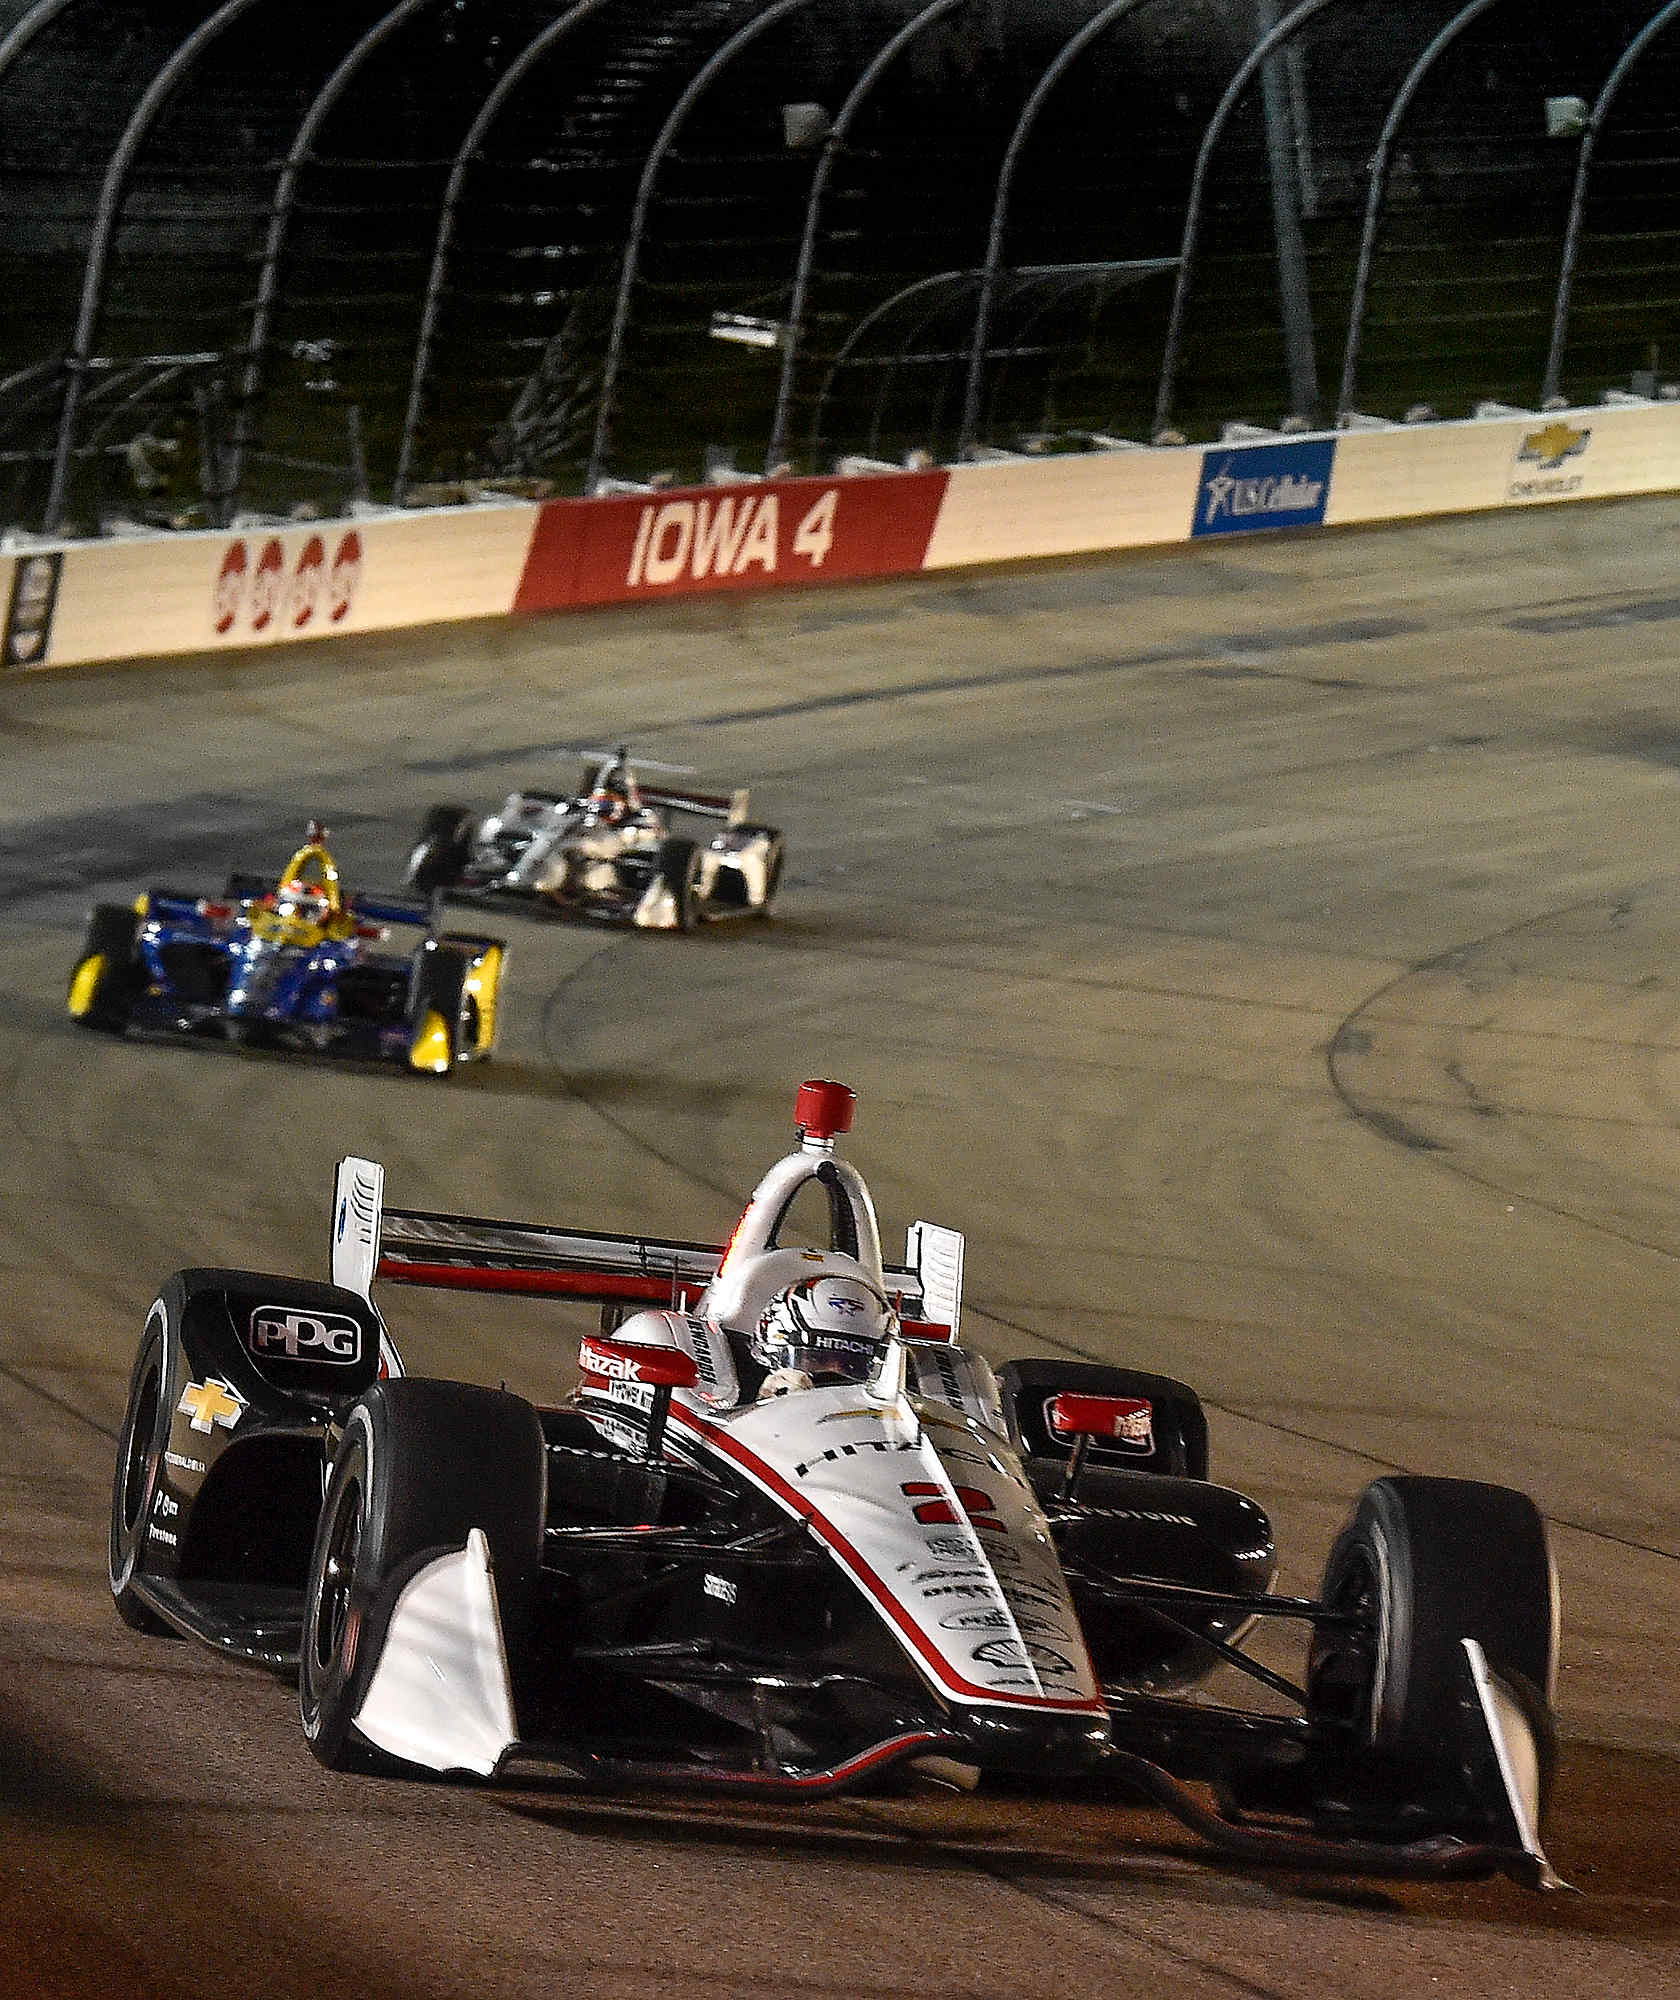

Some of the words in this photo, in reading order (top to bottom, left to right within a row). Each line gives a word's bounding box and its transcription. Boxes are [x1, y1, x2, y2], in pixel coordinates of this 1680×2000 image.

[627, 493, 779, 587] IOWA
[793, 489, 839, 567] 4
[258, 1315, 353, 1355] PPG
[814, 1335, 875, 1355] HITACHI
